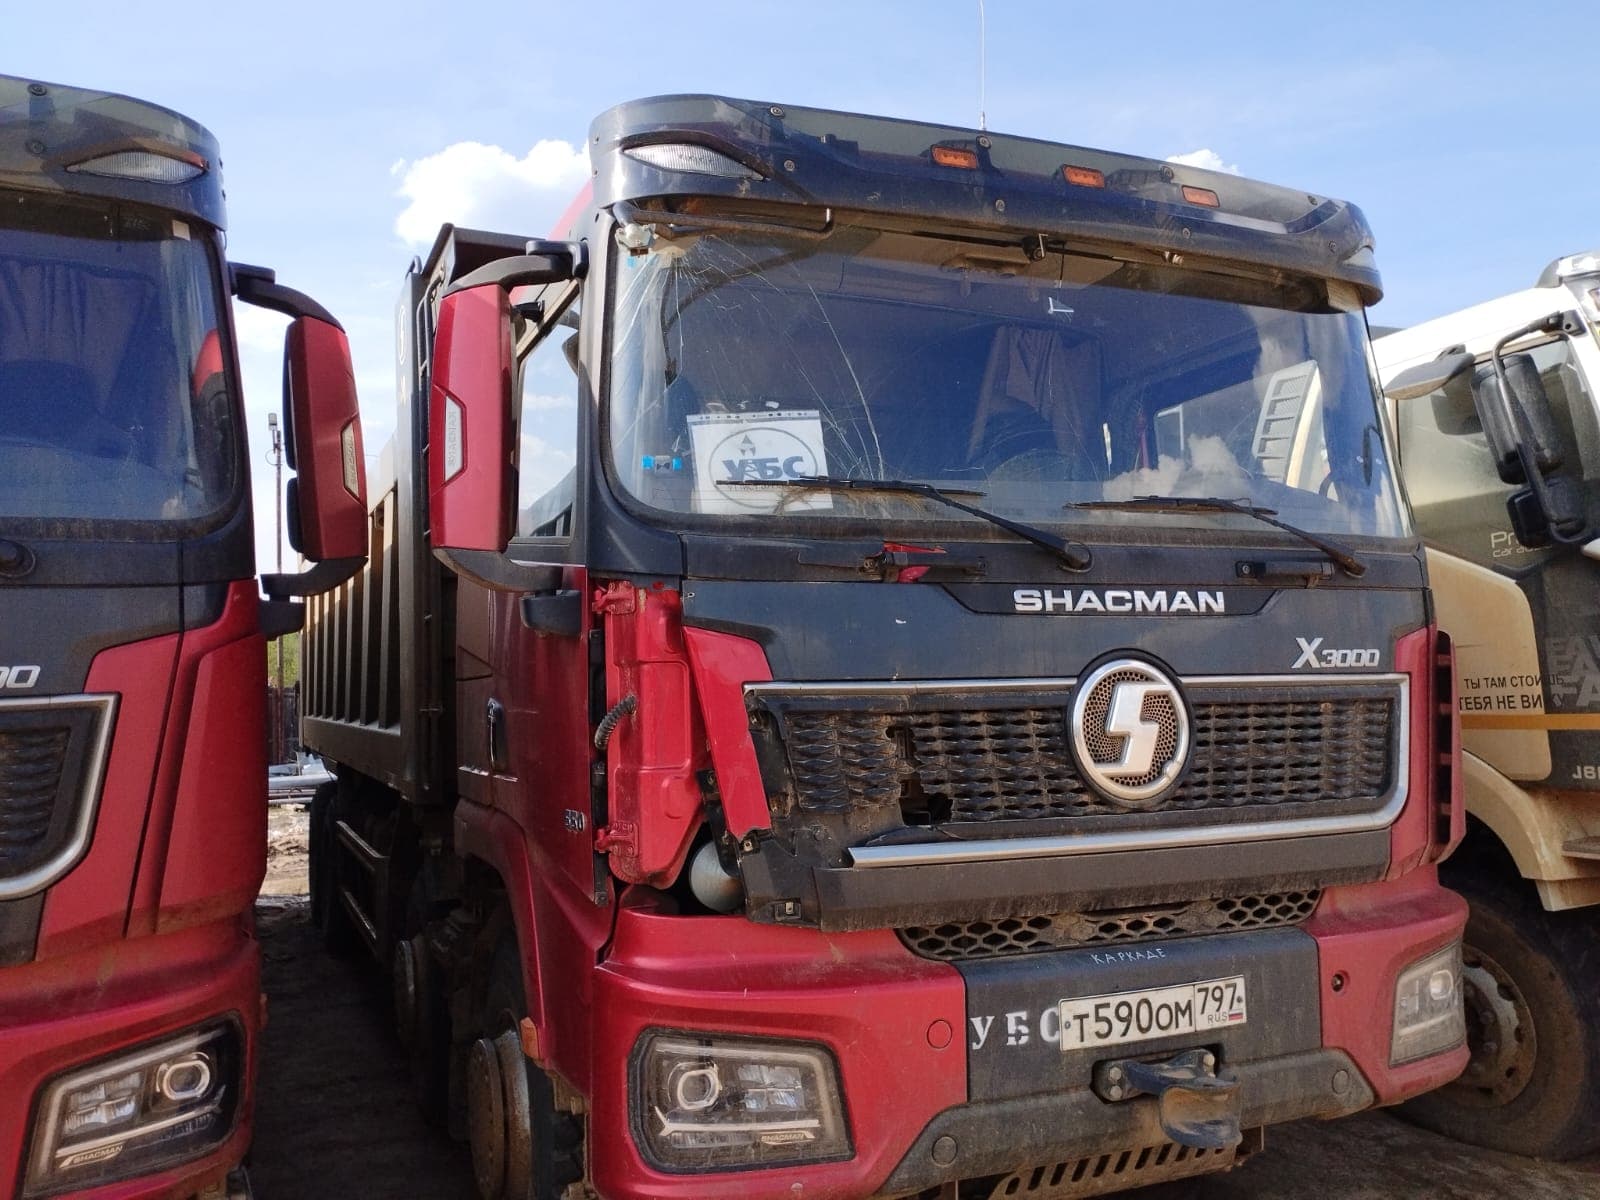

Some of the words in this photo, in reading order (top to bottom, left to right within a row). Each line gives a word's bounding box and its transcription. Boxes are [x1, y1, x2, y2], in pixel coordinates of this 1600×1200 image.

[1013, 589, 1225, 613] SHACMAN
[1291, 637, 1380, 669] X3000
[1463, 678, 1480, 689] ТЫ
[1483, 677, 1507, 688] ТАМ
[1496, 694, 1517, 710] НЕ
[1092, 948, 1167, 965] КАРКАДЕ
[1197, 982, 1238, 1015] 797
[1207, 1013, 1228, 1023] RUS
